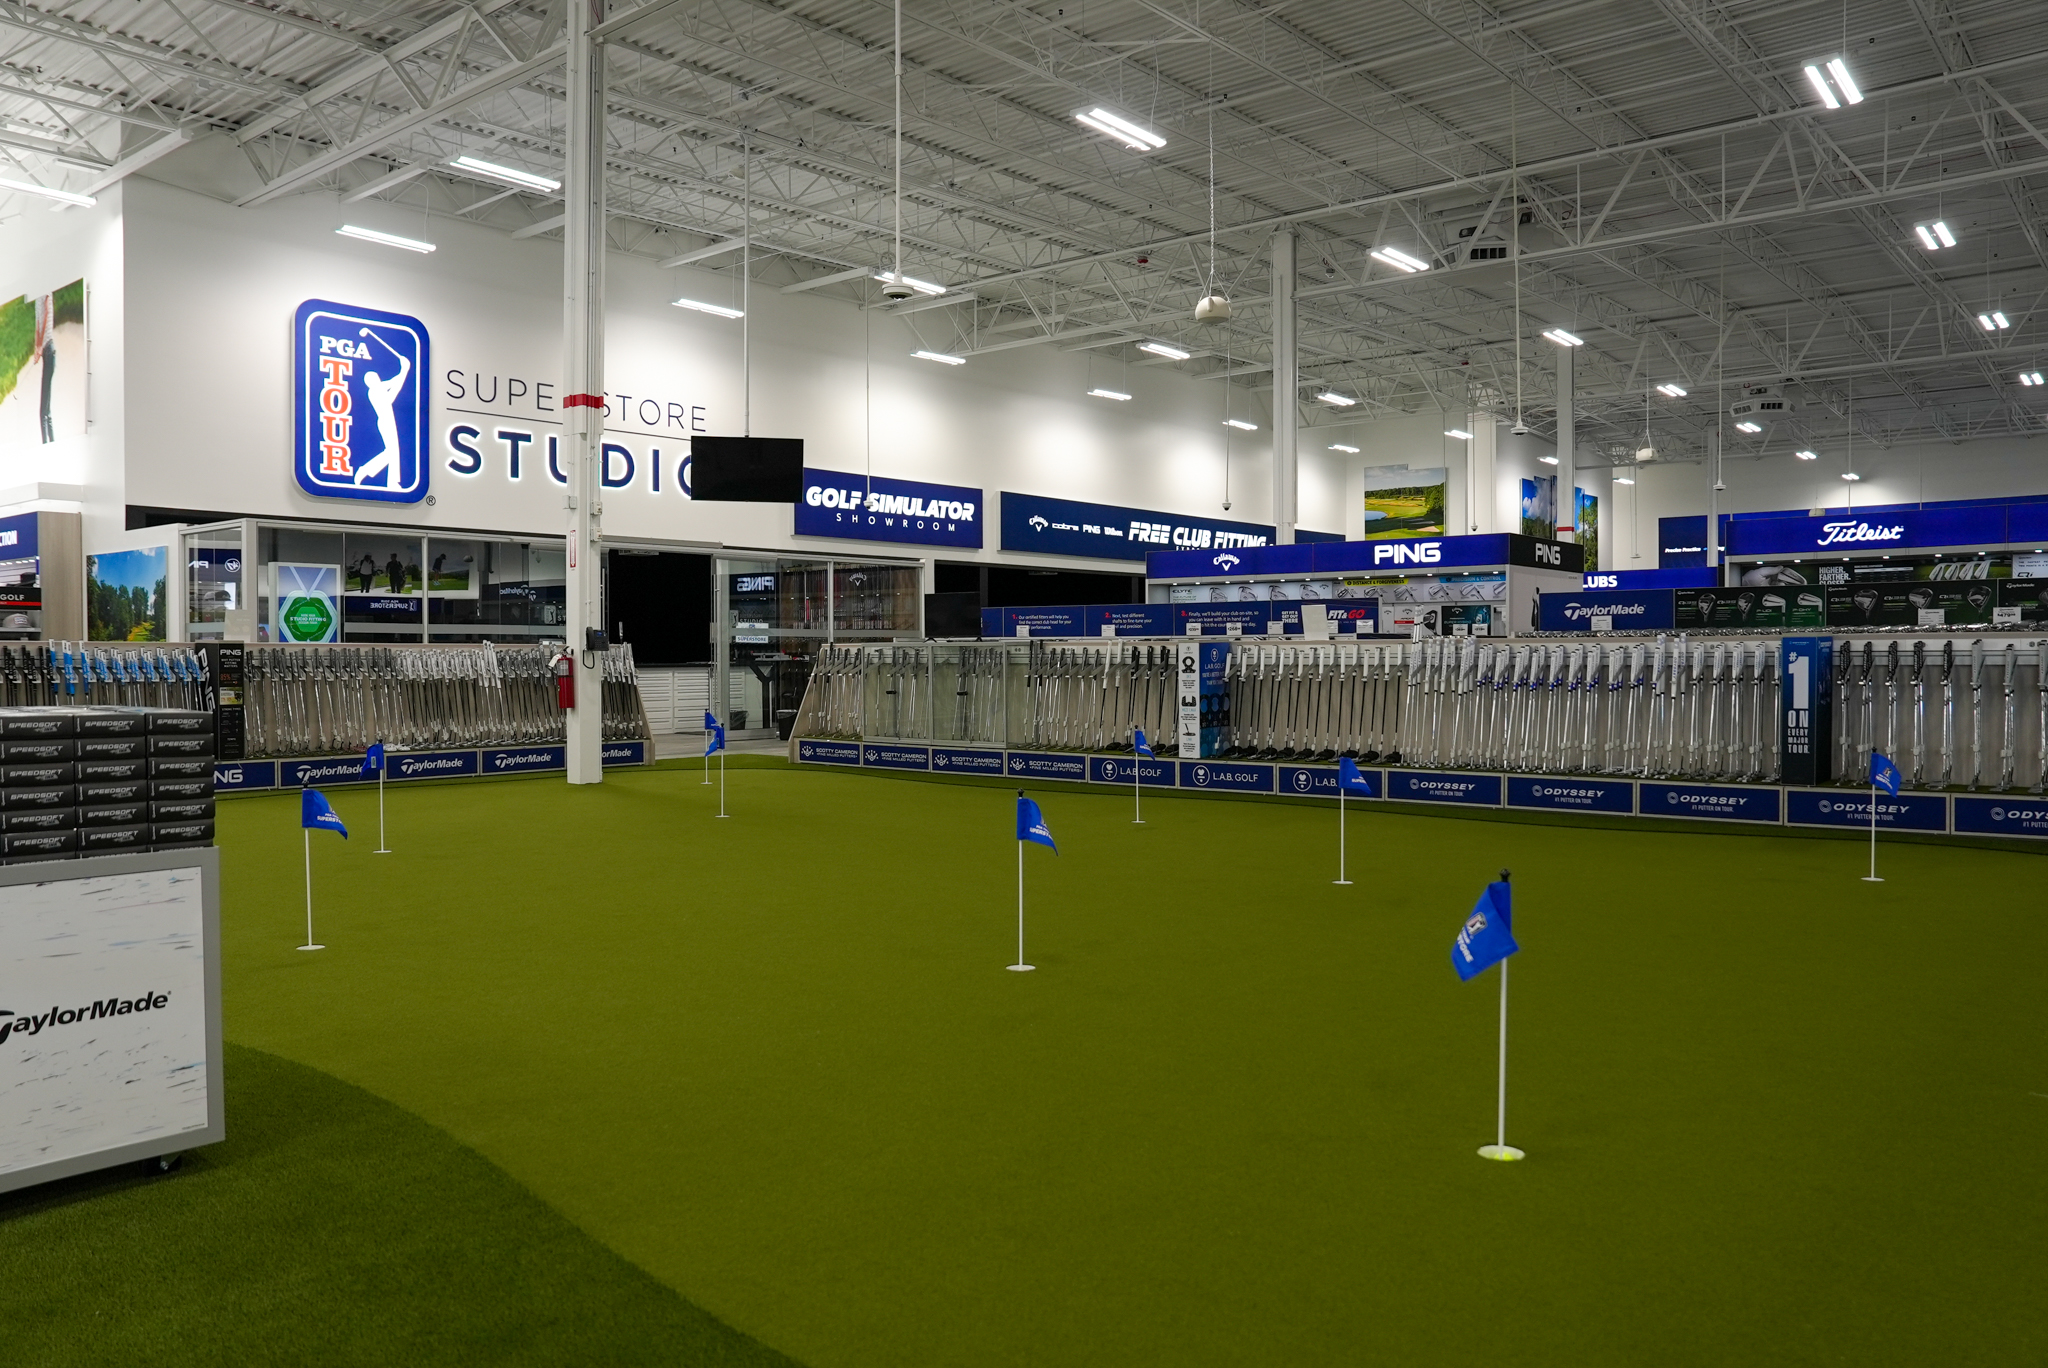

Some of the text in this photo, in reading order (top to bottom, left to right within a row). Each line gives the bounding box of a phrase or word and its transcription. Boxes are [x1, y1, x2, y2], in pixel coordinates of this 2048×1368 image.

[319, 335, 372, 360] PGA
[319, 355, 353, 476] TOUR
[806, 486, 975, 522] GOLF SIMULATOR
[836, 513, 956, 532] SHOWROOM
[1128, 521, 1267, 549] FREE CLUB FITTING
[1817, 520, 1904, 546] Titleist
[1374, 542, 1441, 565] PING
[1535, 542, 1561, 565] PING
[1819, 566, 1846, 574] HIGHER.
[1819, 573, 1852, 581] FARTHER.
[1564, 602, 1646, 621] TaylorMade
[1788, 710, 1809, 727] ON
[8, 721, 62, 729] SPEEDSOFT
[1788, 728, 1808, 736] EVERY
[10, 745, 63, 753] SPEEDSOFT
[495, 753, 552, 769] TaylorMade
[86, 765, 136, 773] SPEEDSOFT
[159, 762, 205, 770] SPEEDSOFT
[401, 758, 464, 775] TaylorMade
[9, 769, 63, 777] SPEEDSOFT
[1139, 768, 1162, 777] GOLF
[1235, 773, 1259, 782] GOLF
[159, 783, 205, 791] SPEEDSOFT
[1420, 781, 1475, 790] ODYSSEY
[88, 786, 137, 795] SPEEDSOFT
[1544, 788, 1605, 797] ODYSSEY
[10, 792, 64, 800] SPEEDSOFT
[1680, 795, 1747, 805] ODYSSEY
[87, 808, 137, 818] SPEEDSOFT
[160, 804, 206, 813] SPEEDSOFT
[11, 814, 64, 824] SPEEDSOFT
[160, 825, 206, 834] SPEEDSOFT
[90, 830, 138, 840] SPEEDSOFT
[13, 836, 66, 846] SPEEDSOFT
